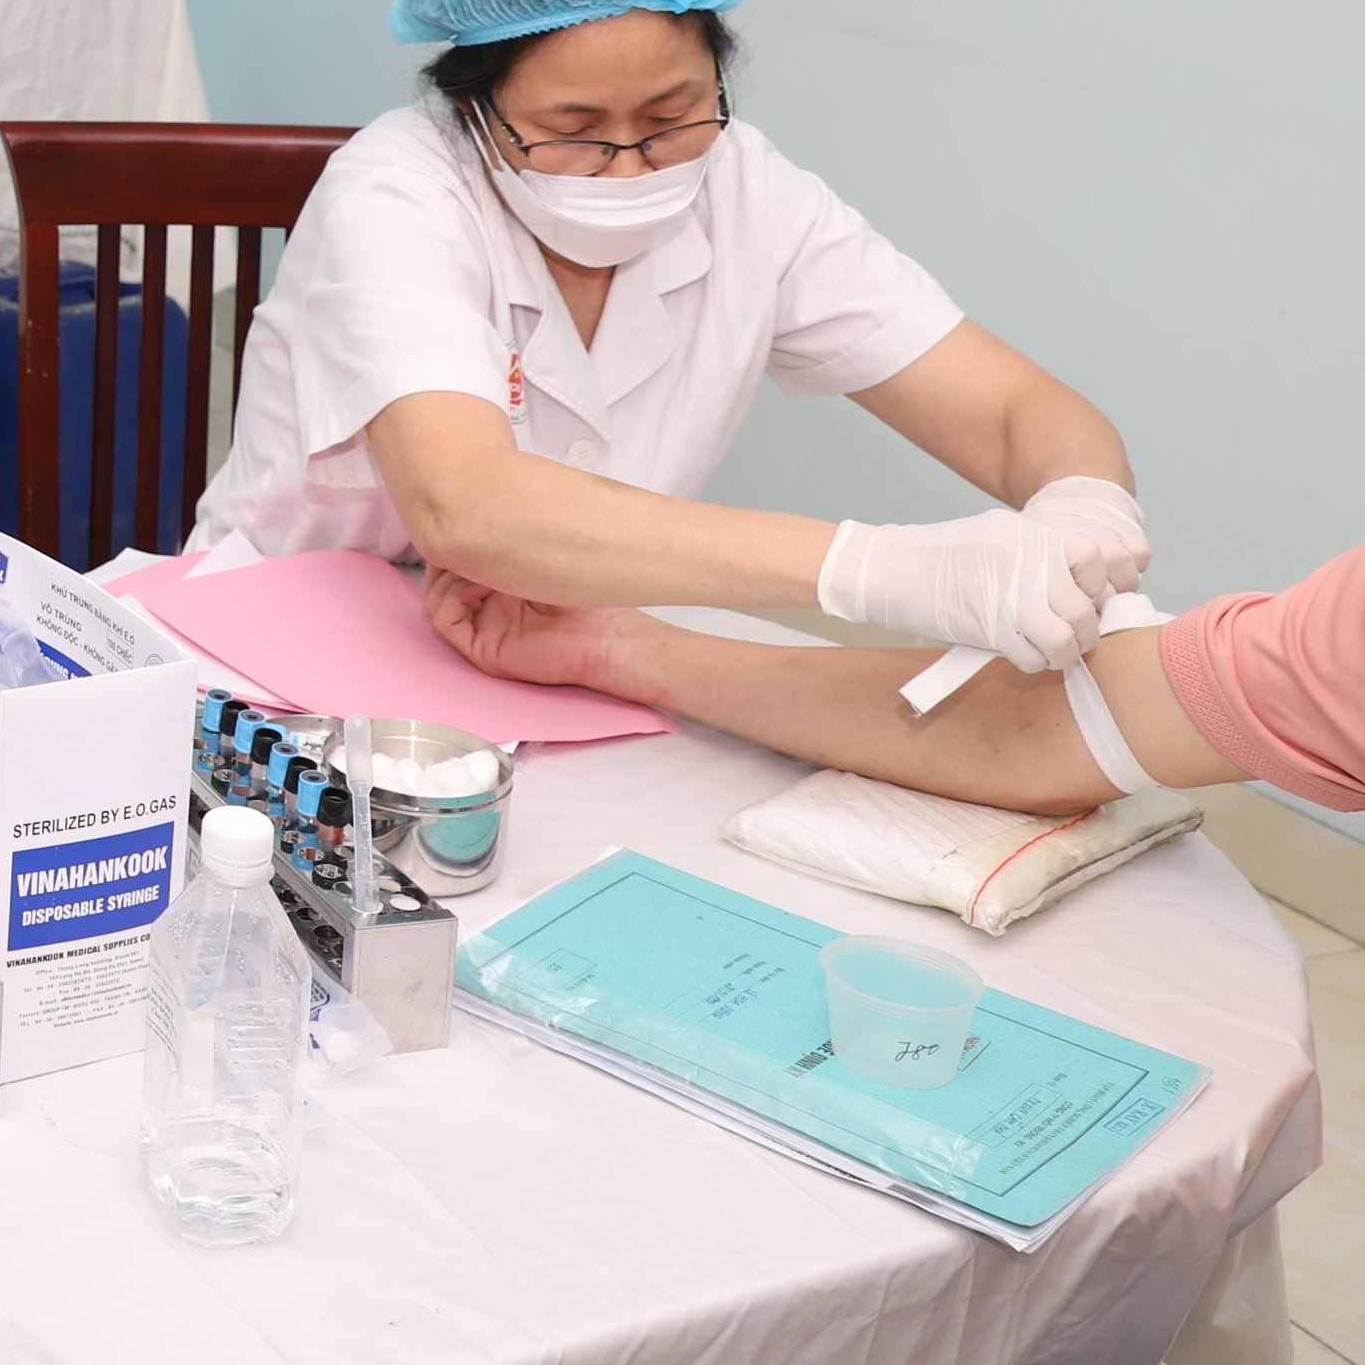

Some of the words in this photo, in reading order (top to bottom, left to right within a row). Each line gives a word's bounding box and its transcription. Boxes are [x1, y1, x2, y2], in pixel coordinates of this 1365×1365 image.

[36, 615, 63, 637] KHÔNG
[13, 812, 97, 838] STERILIZED
[101, 808, 120, 825] BY
[123, 795, 177, 820] E.O.GAS
[17, 845, 169, 897] VINAHANKOOK
[22, 898, 104, 927] DISPOSABLE
[107, 885, 160, 911] SYRINGE
[6, 951, 65, 968] VINAHANKOOK
[67, 945, 101, 958] MEDICAL
[103, 937, 138, 951] SUPPLIES
